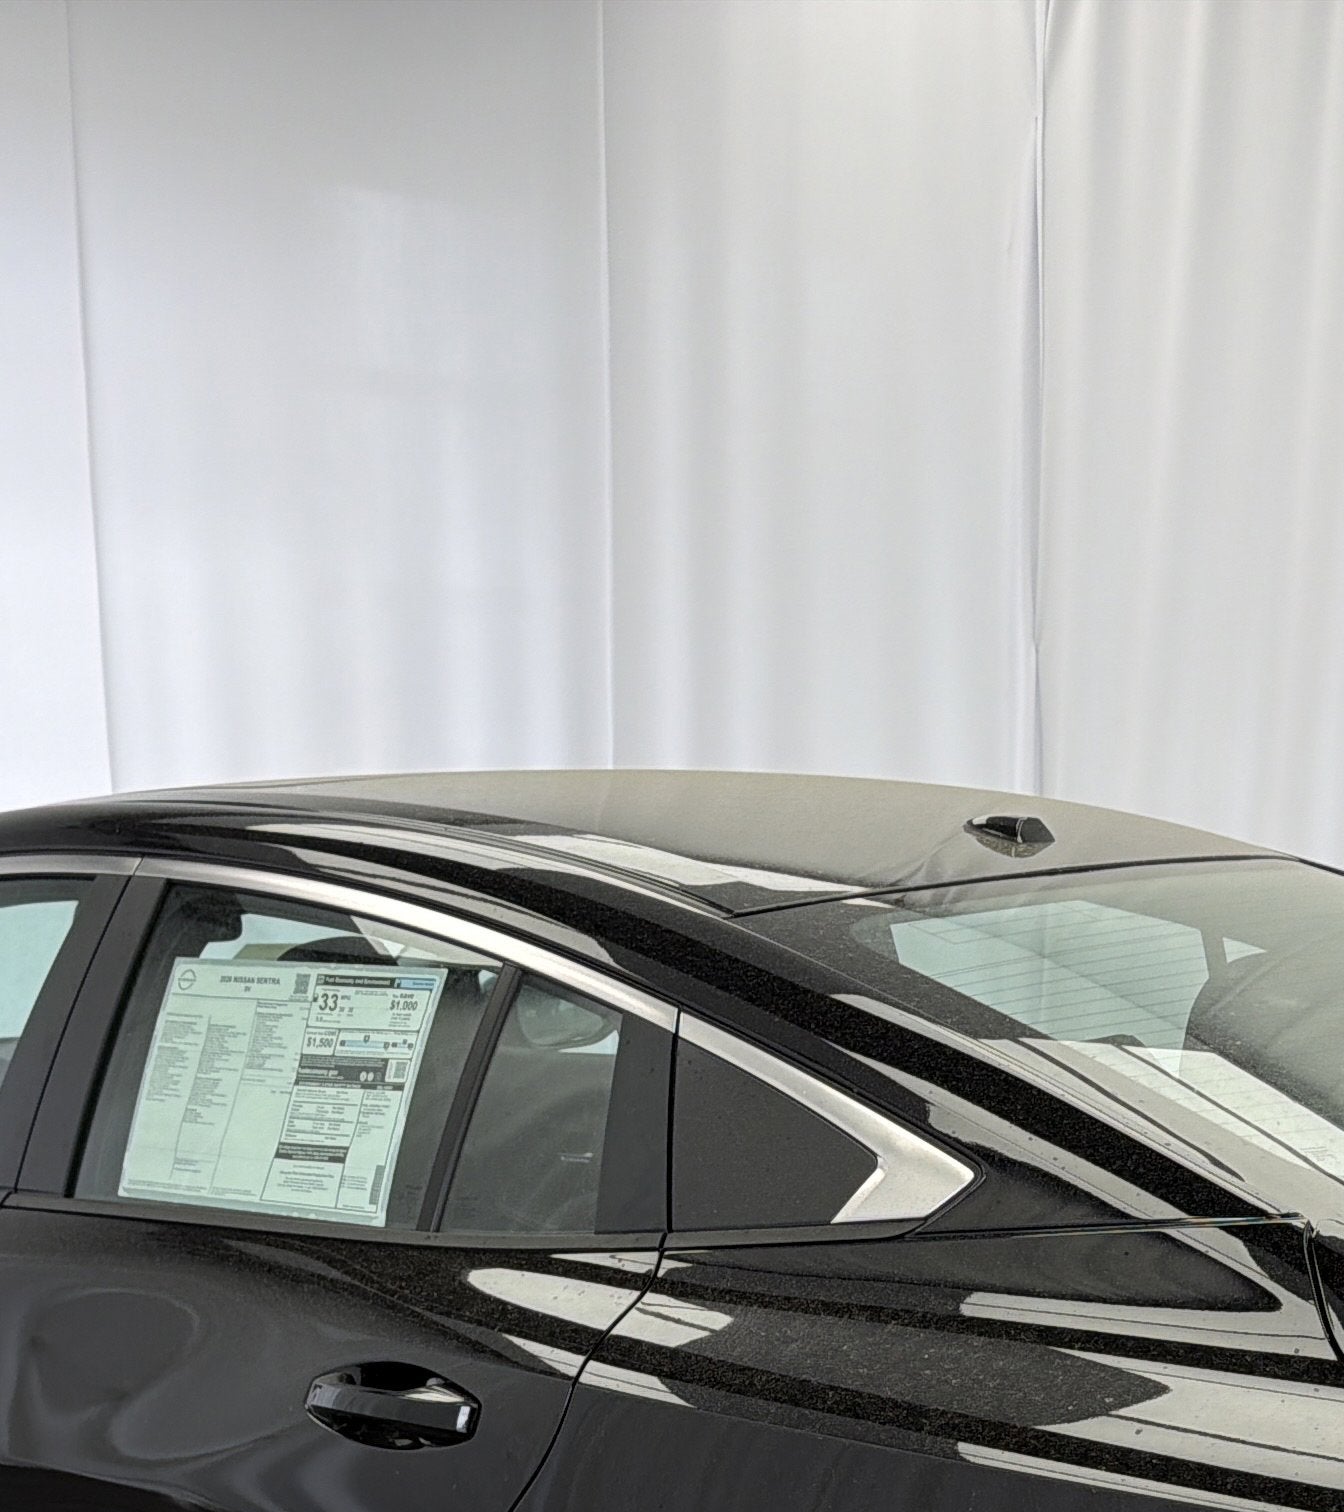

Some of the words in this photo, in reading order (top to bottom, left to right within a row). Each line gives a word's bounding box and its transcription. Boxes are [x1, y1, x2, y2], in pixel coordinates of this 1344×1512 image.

[256, 977, 281, 985] SENTRA
[319, 993, 339, 1011] 33
[306, 1036, 334, 1048] $1,500
